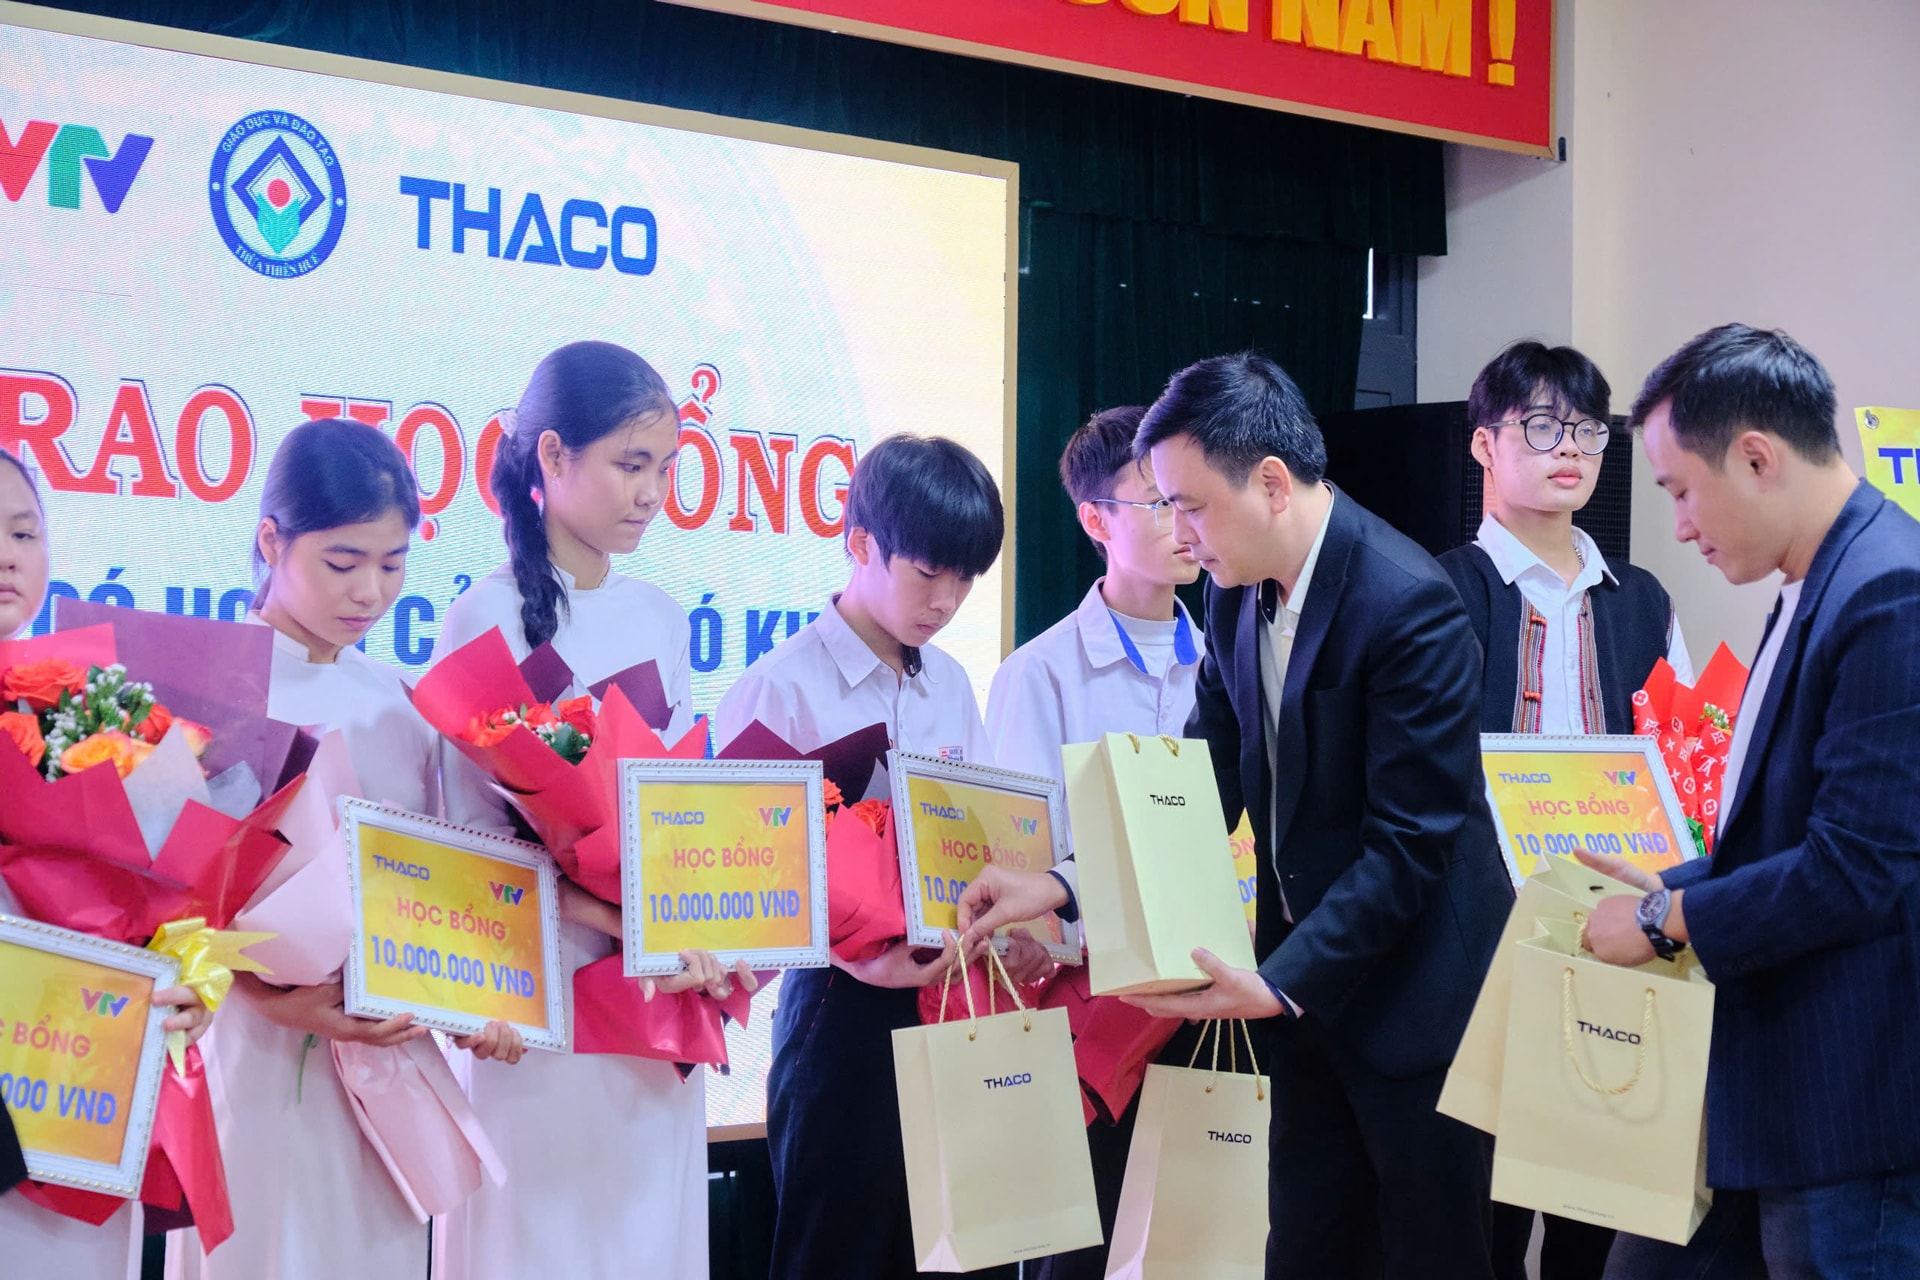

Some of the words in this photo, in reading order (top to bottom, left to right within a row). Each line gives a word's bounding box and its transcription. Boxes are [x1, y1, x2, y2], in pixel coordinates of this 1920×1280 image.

[400, 175, 658, 276] THACO
[1498, 772, 1551, 784] THACO
[1603, 770, 1637, 786] VTV
[920, 802, 966, 821] THACO
[1150, 794, 1186, 807] THACO
[1528, 800, 1572, 820] HỌC
[1577, 792, 1631, 816] BỔNG
[651, 811, 704, 825] THACO
[758, 807, 792, 827] VTV
[1010, 815, 1038, 835] VTV
[673, 848, 716, 874] HỌC
[722, 836, 775, 868] BỔNG
[941, 838, 978, 864] HỌC
[982, 837, 1027, 869] BỔNG
[1623, 832, 1668, 853] VNĐ
[372, 854, 430, 881] THACO
[488, 880, 524, 906] VTV
[650, 891, 754, 922] 10.000.000
[759, 889, 800, 918] VNĐ
[397, 896, 443, 927] HỌC
[449, 903, 506, 942] BỔNG
[371, 935, 485, 988] 10.000.000
[490, 963, 535, 998] VNĐ
[81, 987, 130, 1018] VTV
[12, 1013, 92, 1058] BỔNG
[1577, 1020, 1642, 1045] THACO
[983, 1072, 1032, 1090] THACO
[58, 1083, 117, 1125] VNĐ
[1207, 1130, 1252, 1145] THACO
